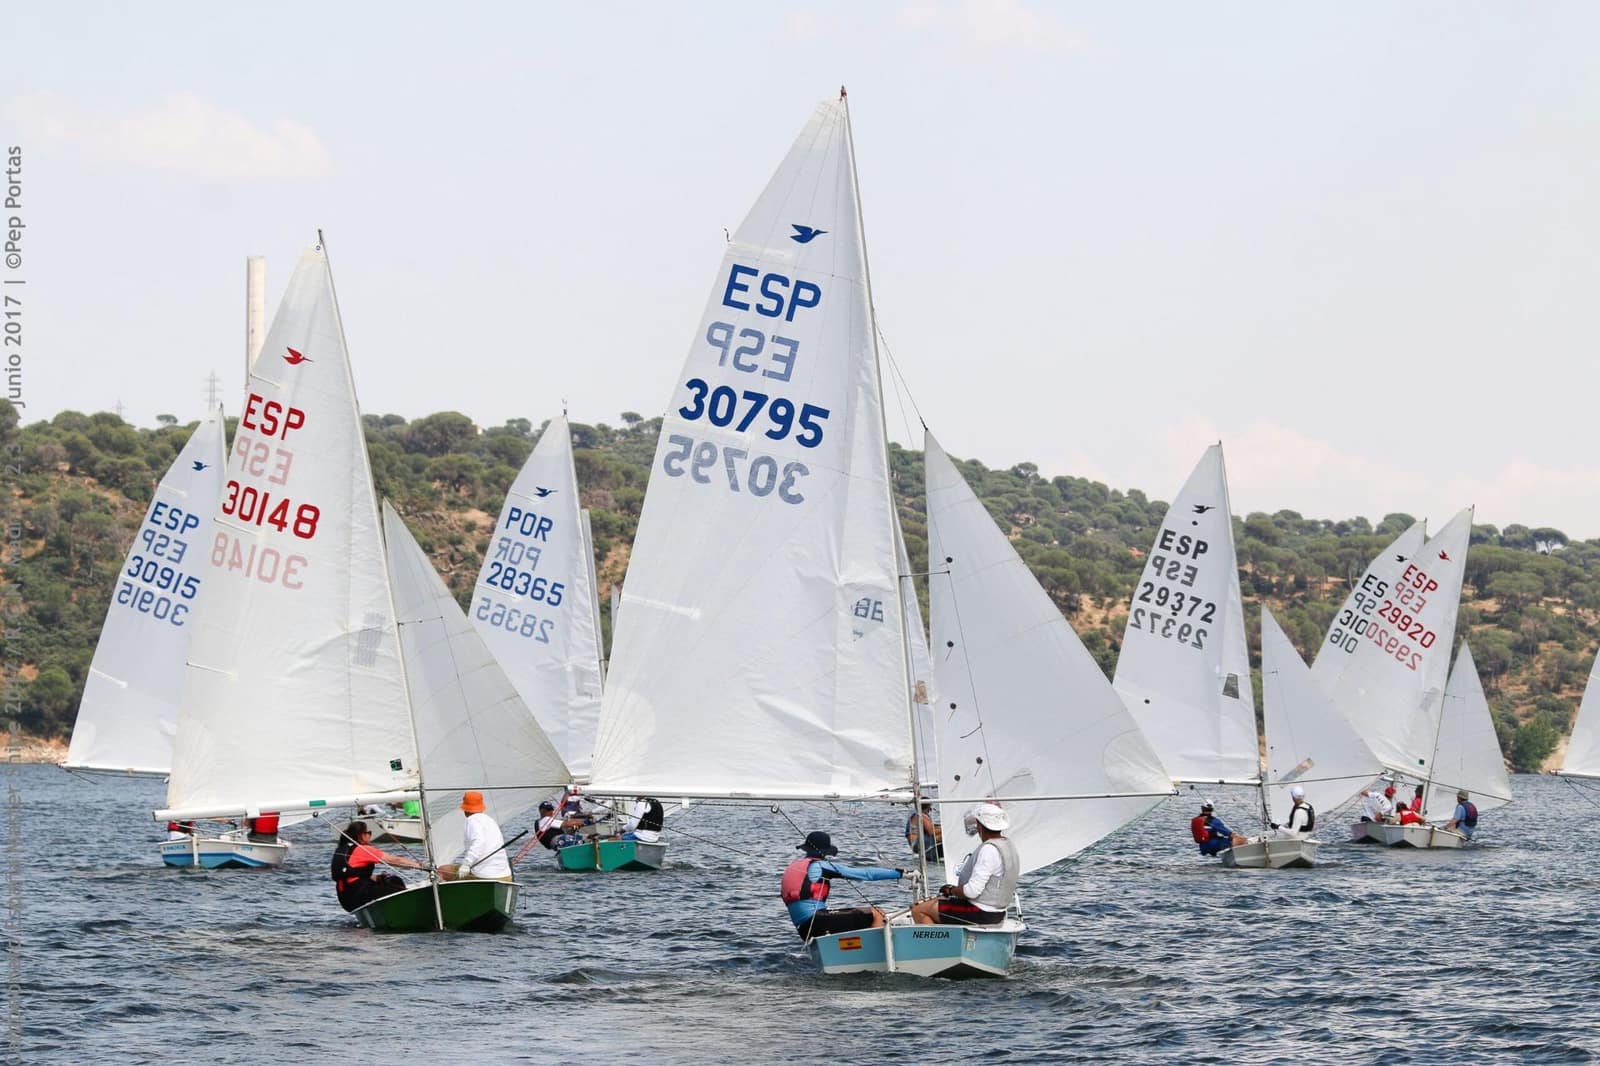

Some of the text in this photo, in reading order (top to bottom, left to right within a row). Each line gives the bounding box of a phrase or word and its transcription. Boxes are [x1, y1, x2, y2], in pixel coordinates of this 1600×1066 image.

[722, 263, 822, 322] ESP
[242, 393, 305, 441] ESP
[678, 378, 830, 448] 30795
[149, 501, 200, 535] ESP
[222, 480, 320, 539] 30148
[505, 507, 553, 542] POR
[1158, 528, 1209, 560] ESP
[127, 555, 200, 599] 30915
[486, 562, 565, 607] 28365
[1361, 574, 1389, 598] ES
[1402, 564, 1438, 593] ESP
[1138, 581, 1217, 624] 29372
[1339, 609, 1369, 635] 310
[1377, 600, 1436, 648] 29920
[912, 930, 950, 939] NEREIDA
